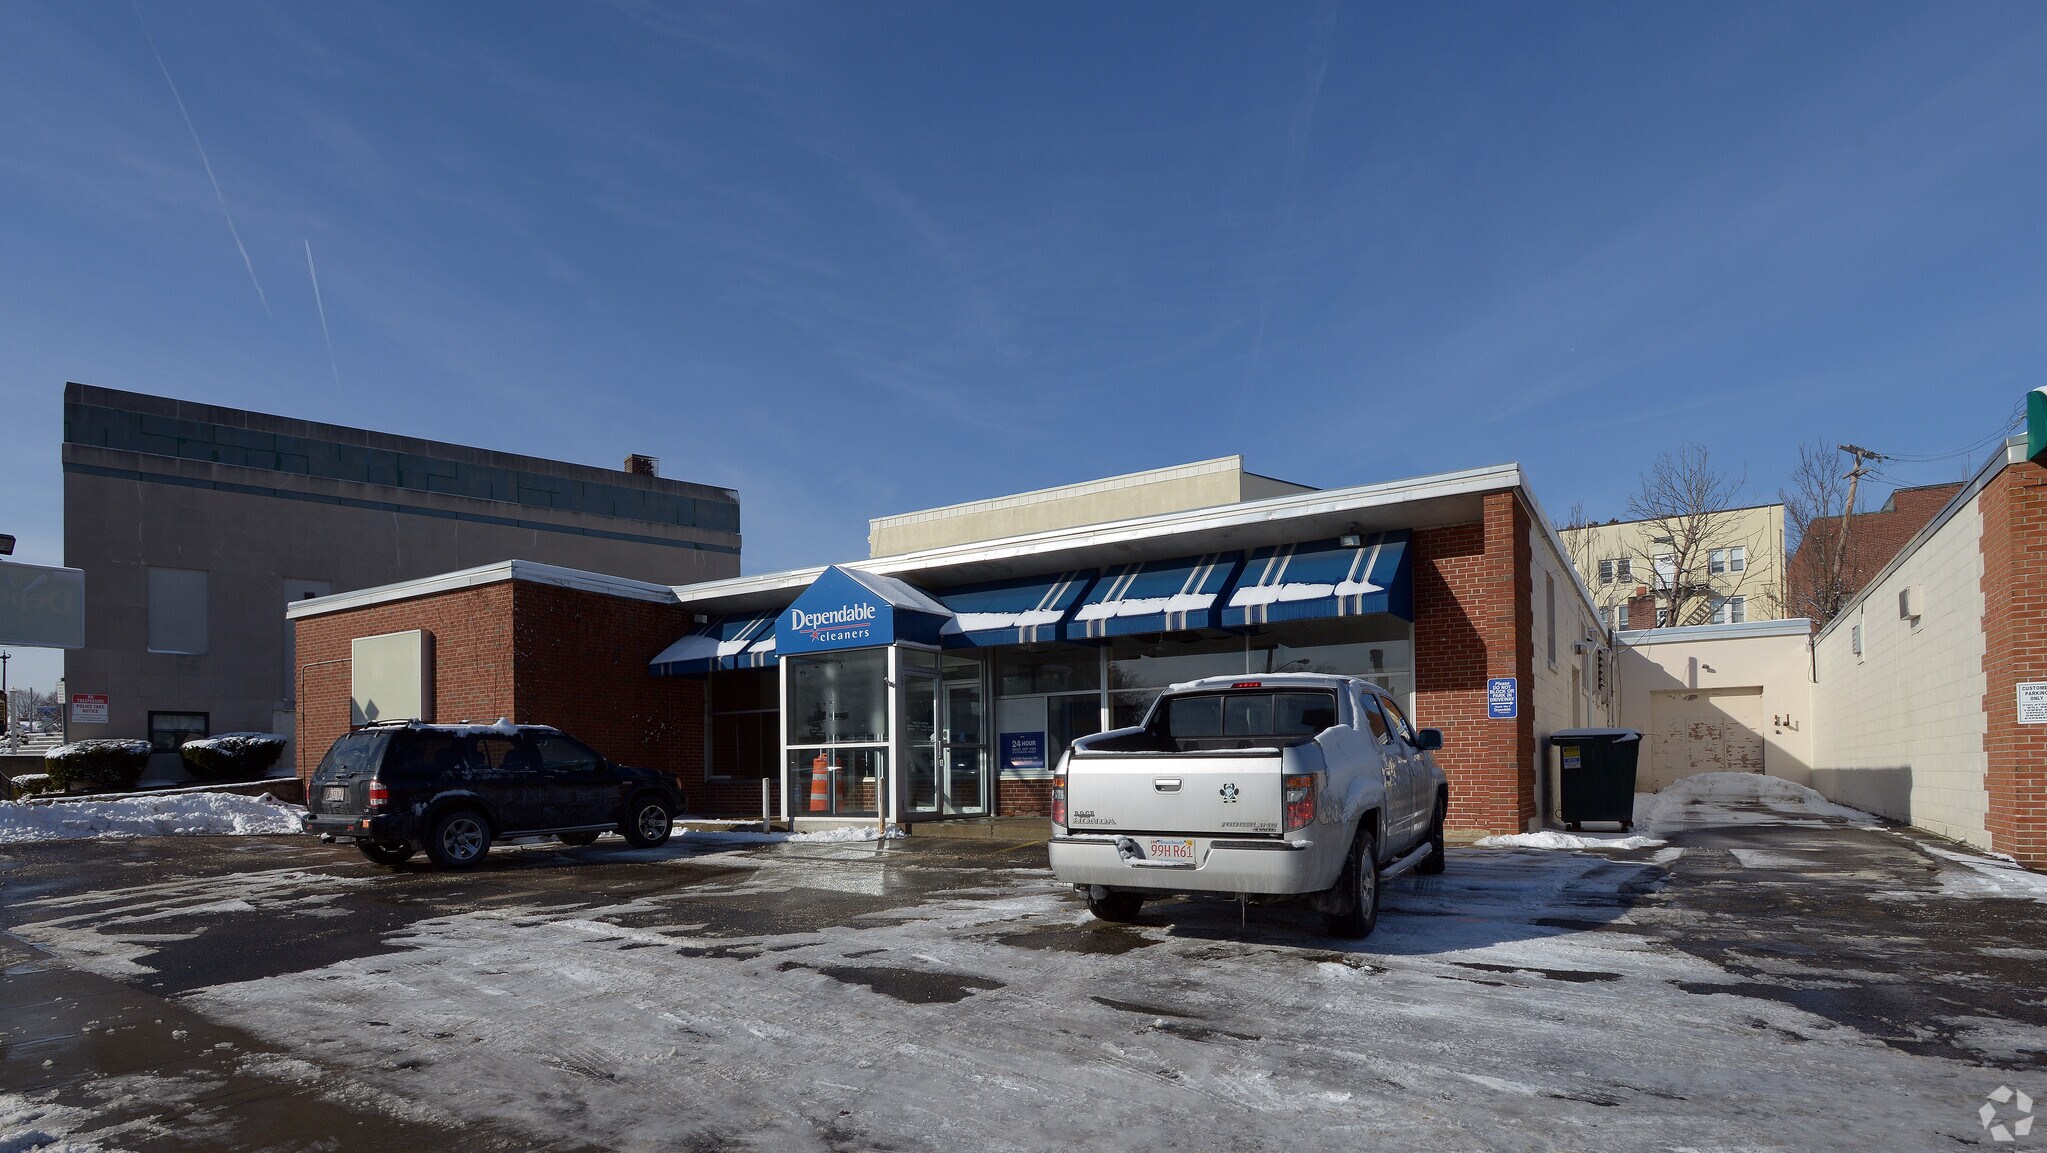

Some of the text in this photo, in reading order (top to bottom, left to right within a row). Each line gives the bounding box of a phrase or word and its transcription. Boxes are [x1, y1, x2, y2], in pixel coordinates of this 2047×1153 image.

[791, 603, 876, 630] Dependable
[820, 629, 870, 642] cleaners
[1012, 740, 1021, 748] 24
[1073, 817, 1117, 825] HONDA
[1151, 844, 1193, 858] 99H R61
